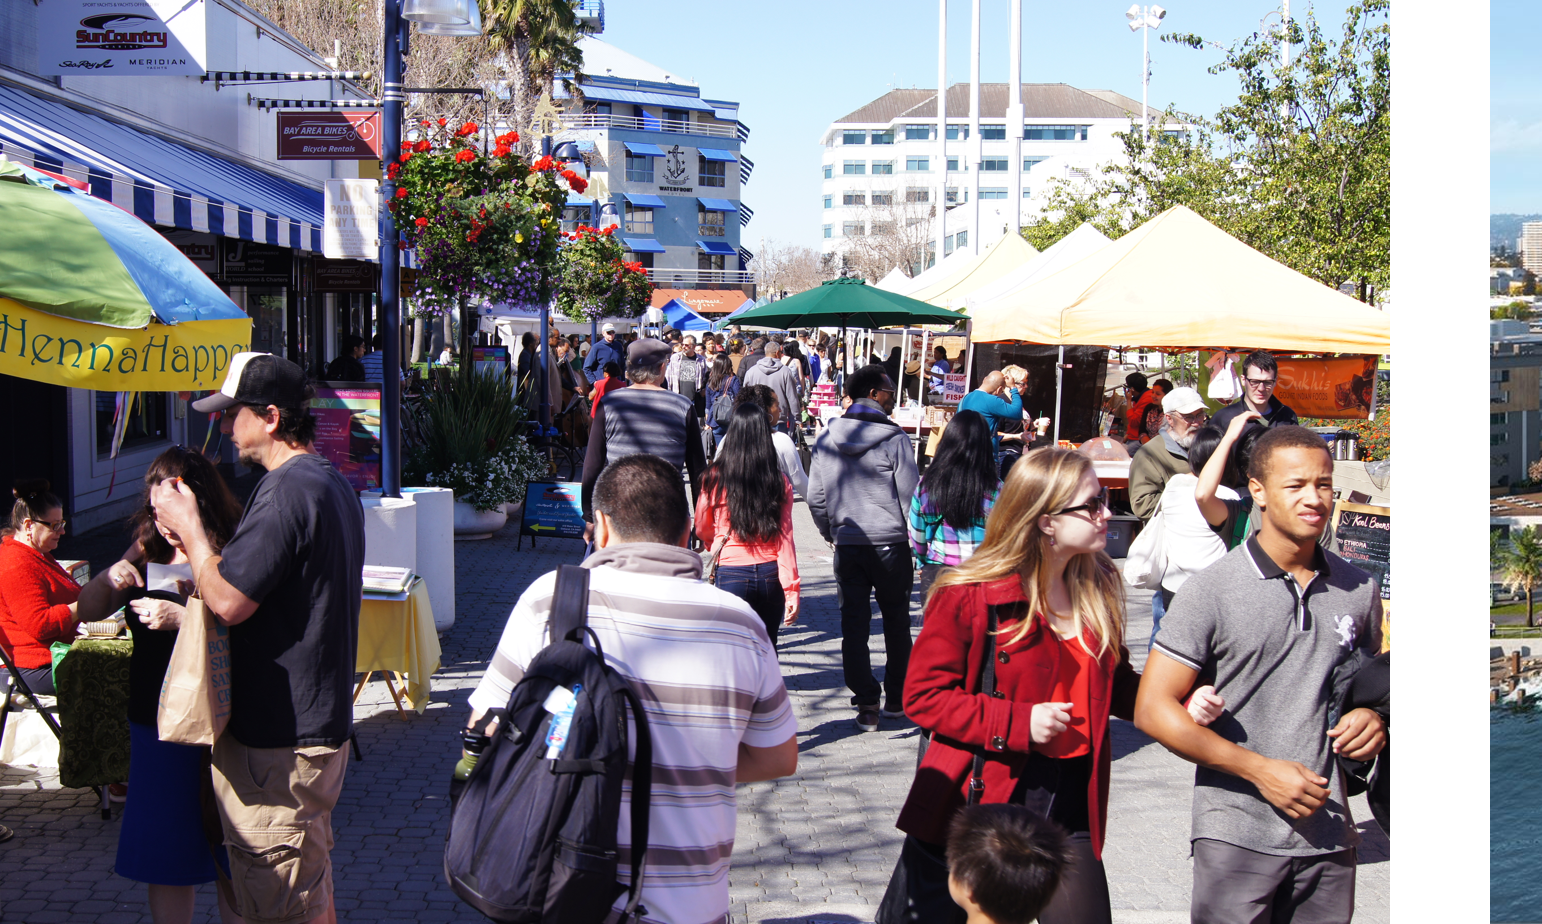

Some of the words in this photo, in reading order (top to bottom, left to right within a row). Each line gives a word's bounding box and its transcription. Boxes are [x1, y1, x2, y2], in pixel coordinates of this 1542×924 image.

[76, 29, 167, 48] SunCountry
[283, 127, 300, 135] BAY
[301, 127, 322, 135] AREA
[324, 127, 347, 135] BIKES
[302, 145, 327, 154] Bicycle
[328, 145, 355, 153] Rentals
[340, 184, 364, 203] NO
[330, 205, 373, 216] PARKING
[329, 218, 348, 228] ANY
[352, 218, 375, 228] TIME
[228, 241, 245, 261] J
[1277, 366, 1331, 391] Sukhi's
[1313, 393, 1328, 401] FOODS
[311, 399, 334, 408] LAY
[1352, 515, 1369, 529] Kool
[1369, 517, 1390, 531] Beans
